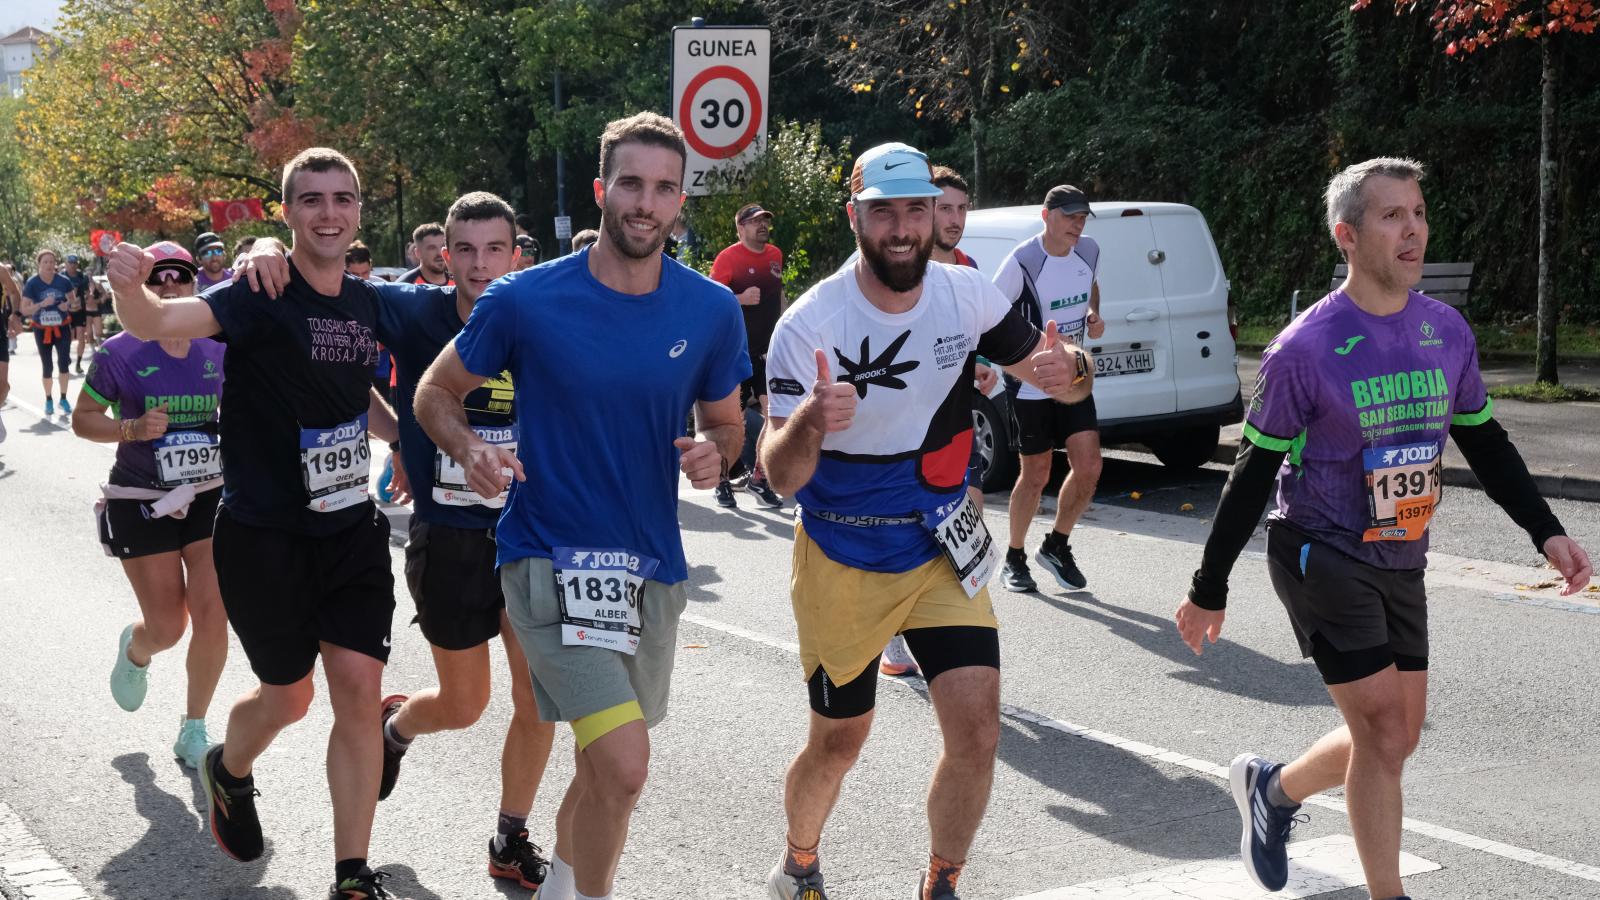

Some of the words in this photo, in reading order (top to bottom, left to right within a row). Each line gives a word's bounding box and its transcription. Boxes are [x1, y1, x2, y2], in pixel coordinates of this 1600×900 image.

[688, 40, 757, 57] GUNEA
[700, 99, 744, 129] 30
[312, 346, 349, 362] KROSA
[1094, 357, 1123, 373] 924
[1126, 353, 1151, 370] KHH
[854, 367, 887, 382] BROOKS
[1351, 368, 1449, 409] BEHOBIA
[1359, 408, 1386, 428] SAN
[163, 446, 220, 468] 17997
[180, 468, 208, 477] VIRGINIA
[336, 473, 355, 482] OIER
[1377, 462, 1439, 500] 13978
[944, 500, 980, 549] 18382
[567, 577, 638, 609] 1833
